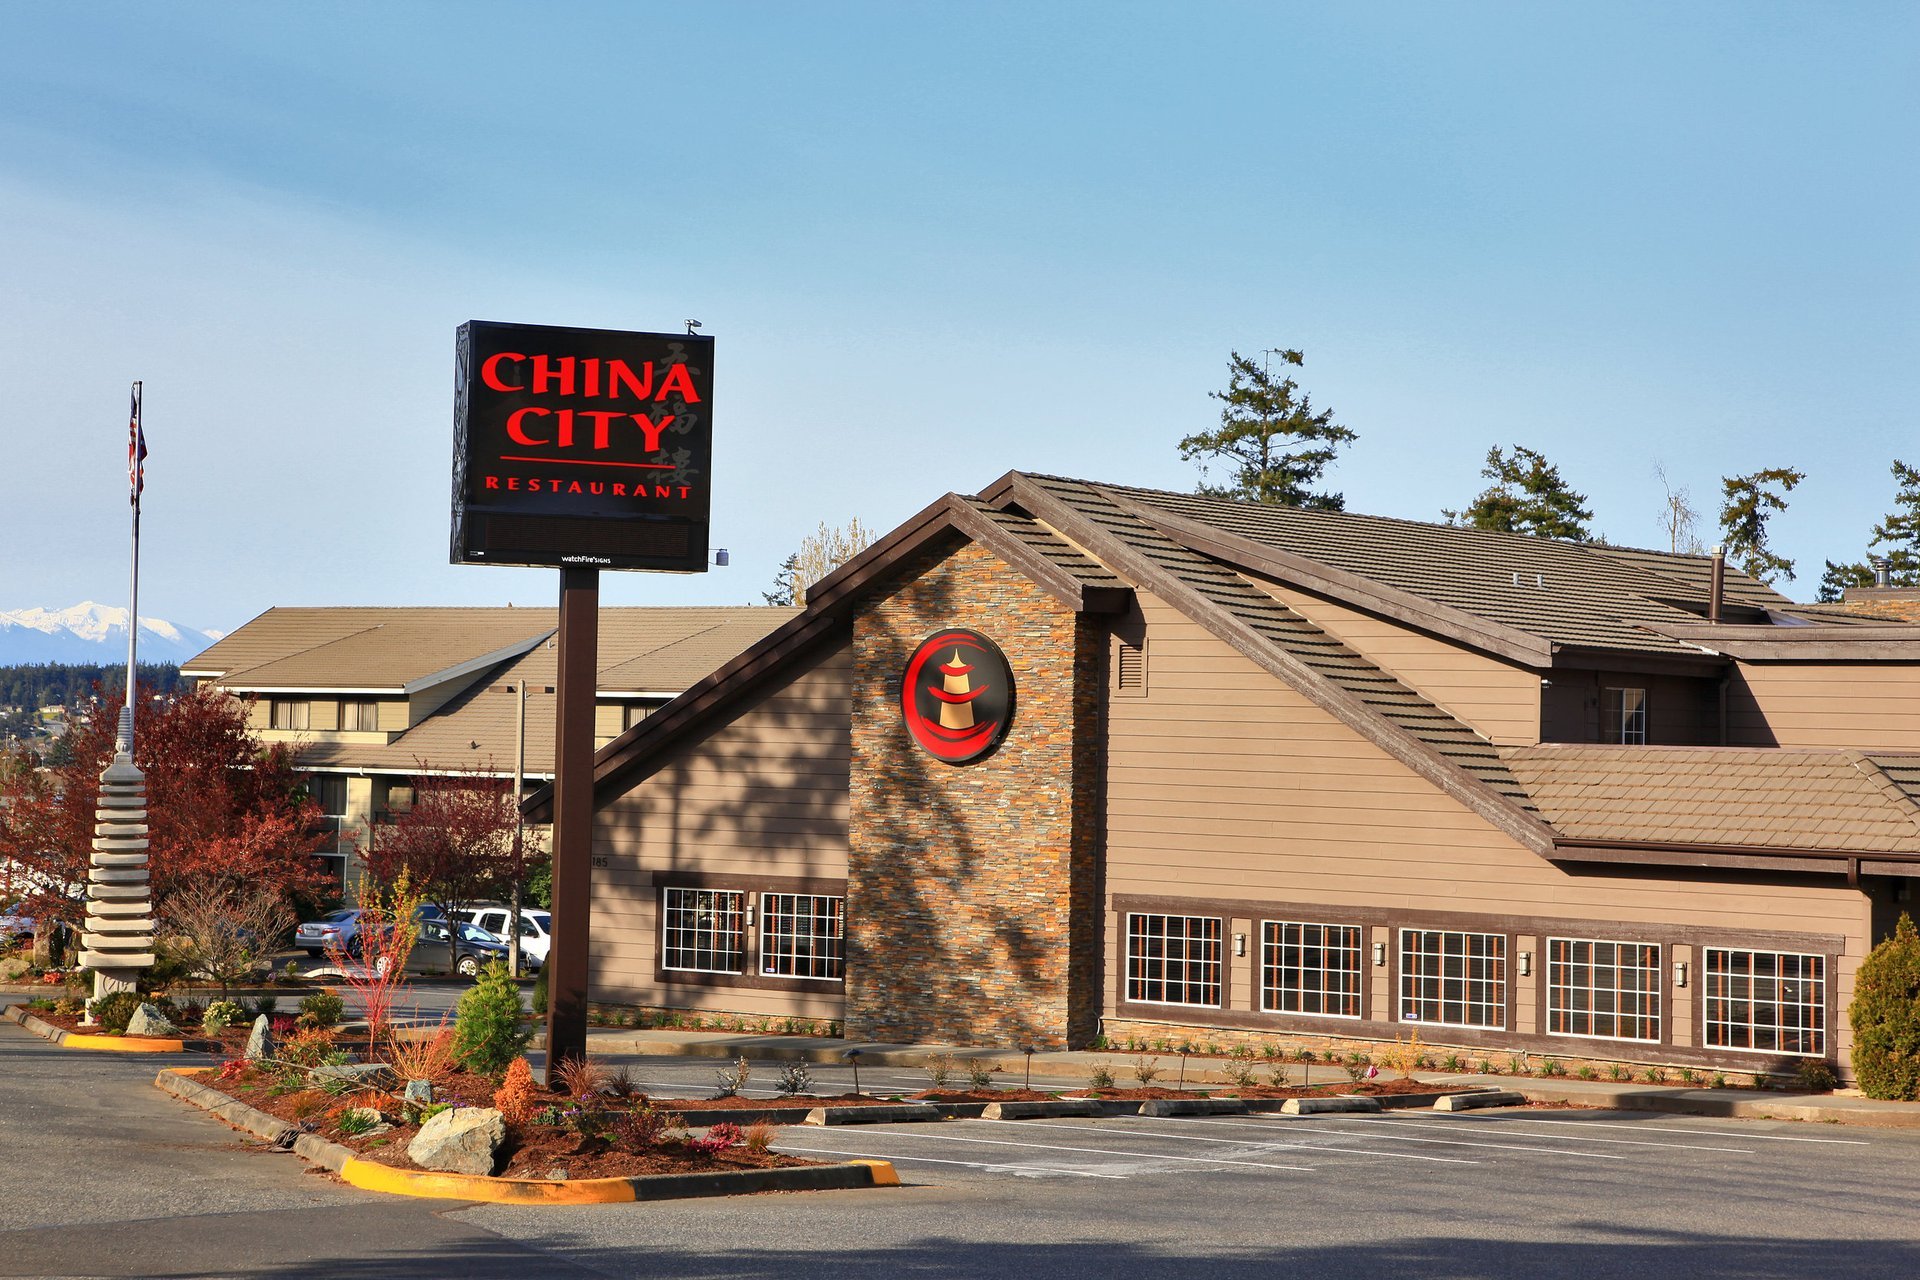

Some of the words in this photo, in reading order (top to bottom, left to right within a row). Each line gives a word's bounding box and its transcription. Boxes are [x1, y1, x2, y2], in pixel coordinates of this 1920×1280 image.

[481, 352, 701, 404] CHINA
[506, 407, 676, 453] CITY
[485, 476, 692, 499] RESTAURANT
